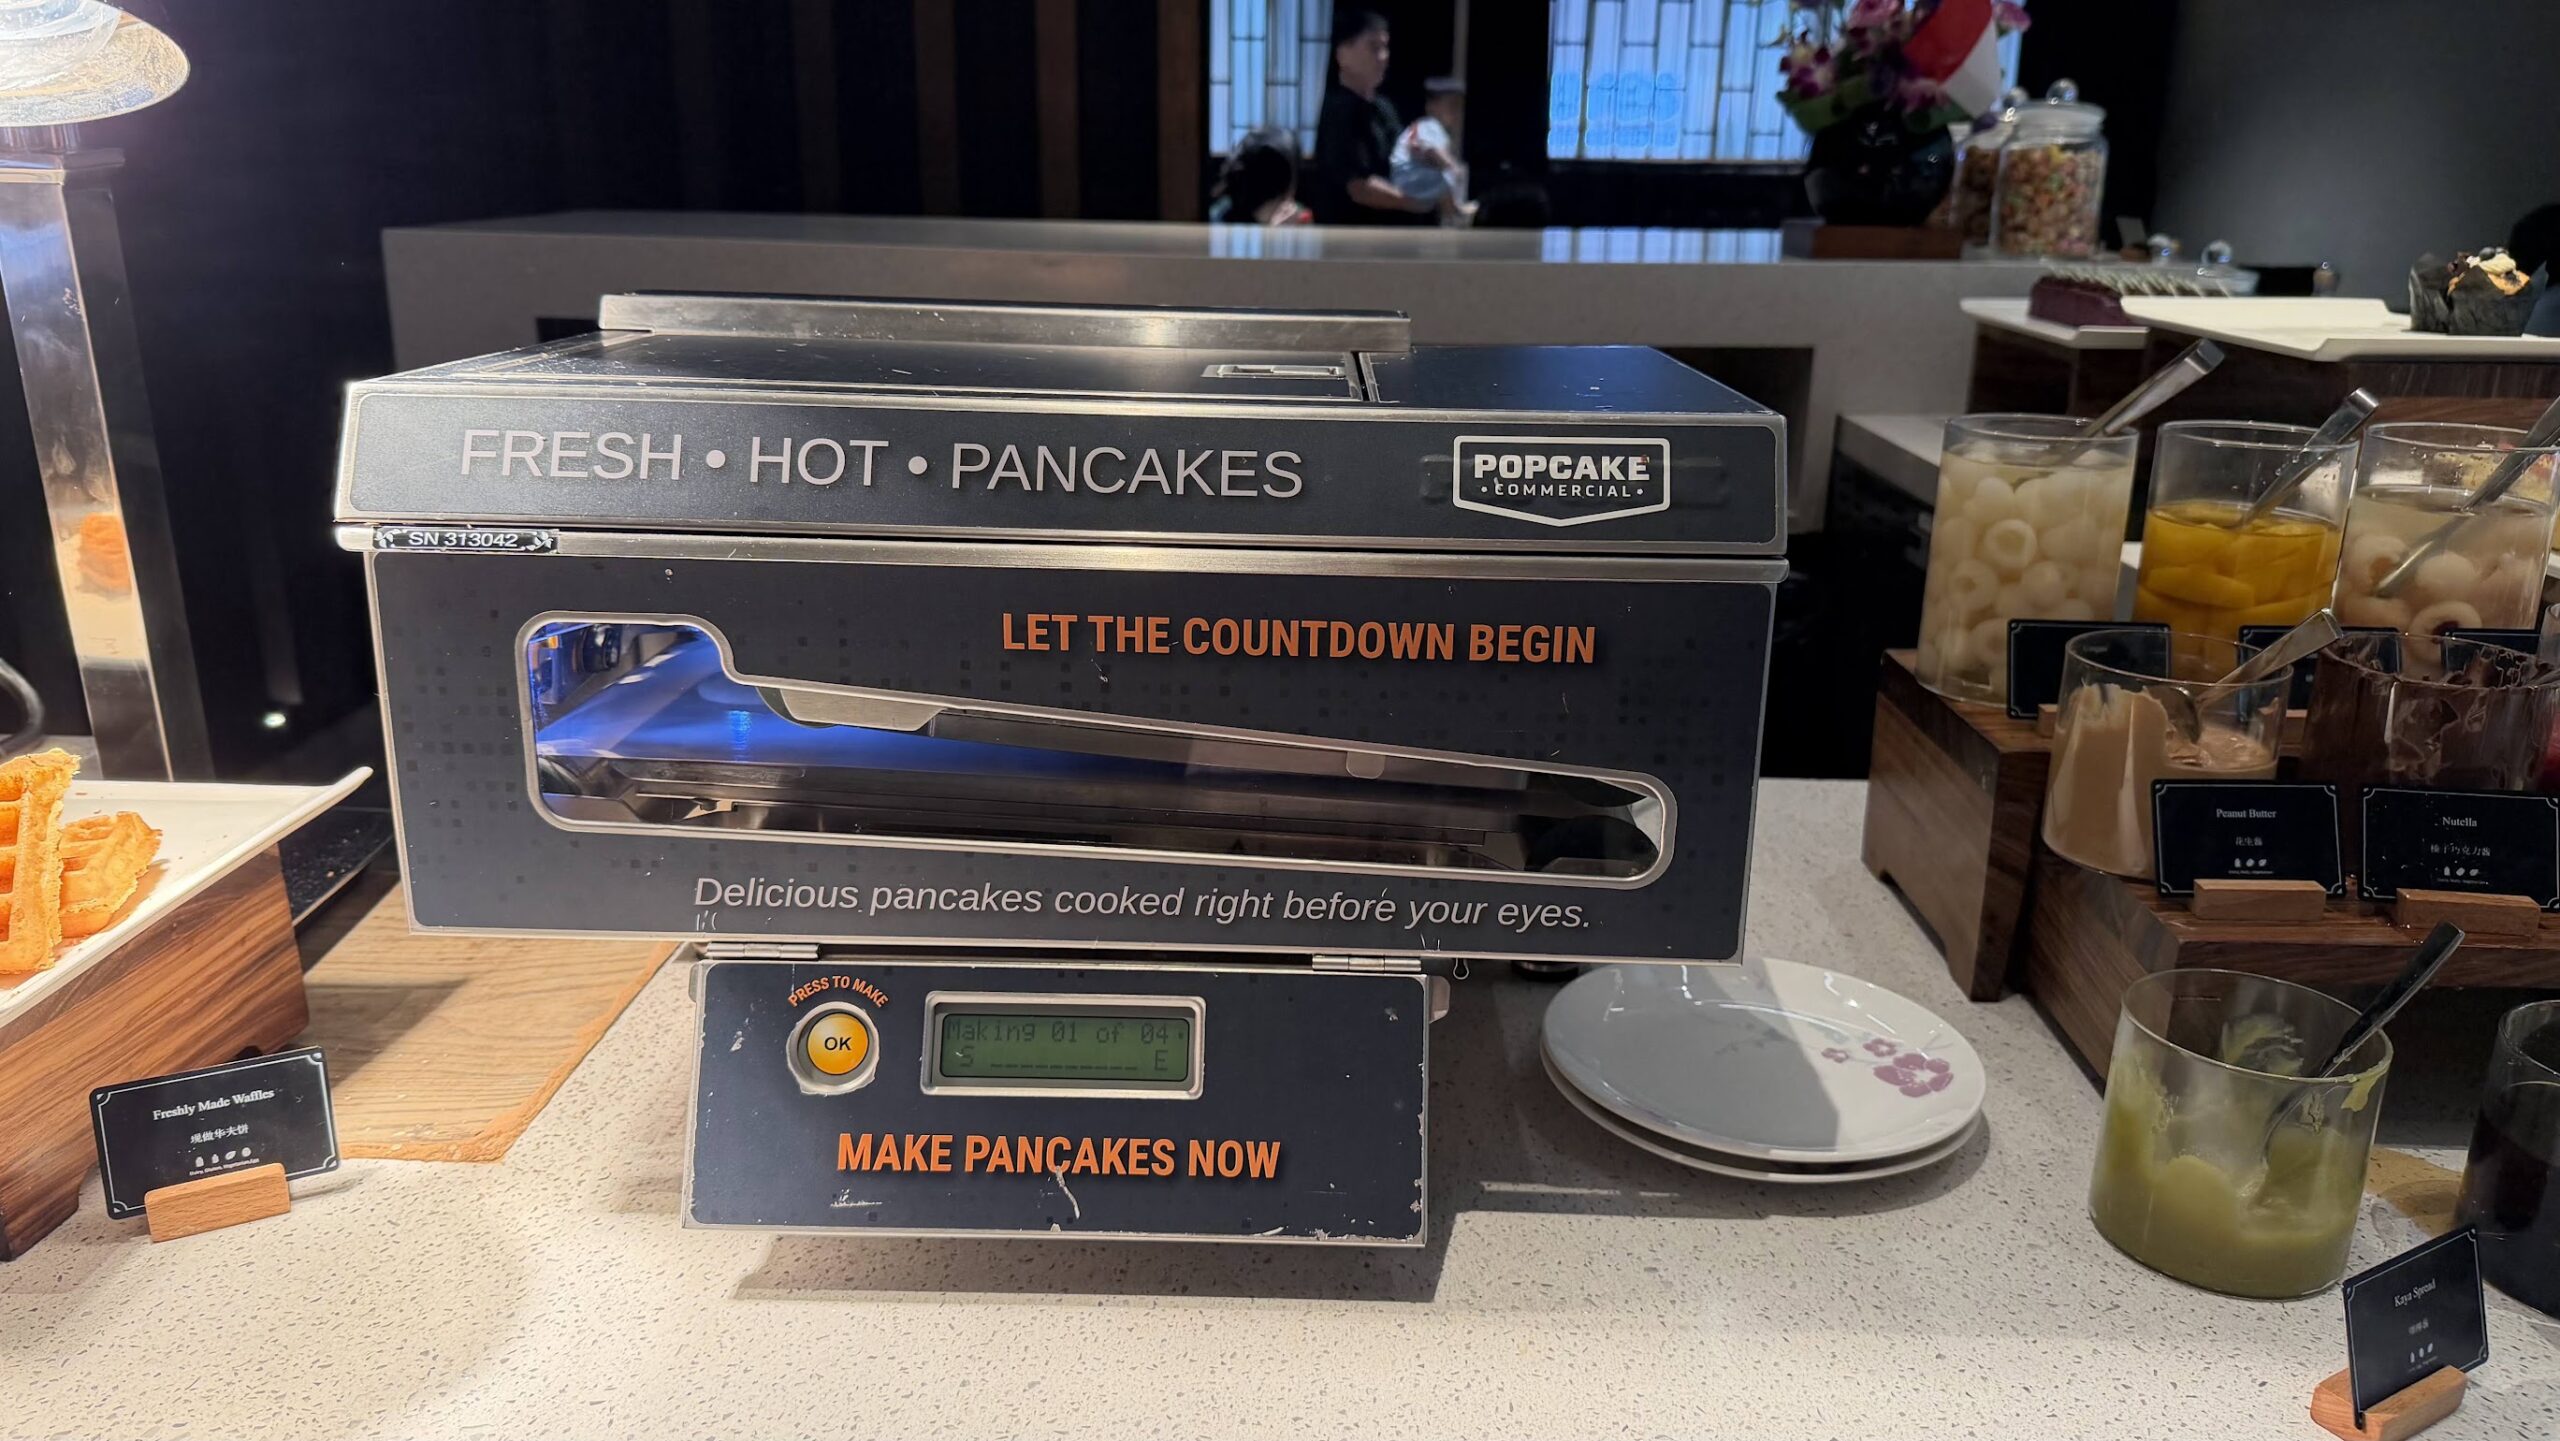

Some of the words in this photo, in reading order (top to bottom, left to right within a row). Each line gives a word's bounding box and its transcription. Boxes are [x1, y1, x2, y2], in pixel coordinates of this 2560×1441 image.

[461, 428, 682, 480] FRESH
[750, 436, 889, 486] HOT
[951, 443, 1303, 497] PANCAKES
[1474, 454, 1650, 481] POPCAKE
[1495, 483, 1631, 497] COMMERCIAL
[408, 531, 439, 546] SN
[444, 532, 518, 547] 313042
[1002, 612, 1078, 651] LET
[1087, 614, 1171, 654] THE
[1183, 616, 1455, 661] COUNTDOWN
[1468, 623, 1596, 664] BEGIN
[2216, 808, 2247, 818] Peanut
[2249, 808, 2277, 818] Butter
[2442, 816, 2478, 827] Nutella
[695, 877, 859, 909] Delicious
[869, 882, 1043, 916] pancakes
[1054, 885, 1186, 917] cooked
[1194, 888, 1274, 924] right
[1283, 891, 1396, 921] before
[1404, 899, 1488, 930] your
[1497, 902, 1591, 933] eyes.
[788, 977, 830, 1007] PRESS
[832, 975, 850, 988] TO
[852, 978, 889, 1007] MAKE
[824, 1036, 852, 1051] OK
[946, 1020, 1036, 1042] Making
[1052, 1021, 1078, 1042] 01
[1096, 1022, 1122, 1043] of
[1141, 1023, 1169, 1044] 04
[153, 1104, 195, 1120] Freshly
[198, 1098, 231, 1112] Made
[233, 1090, 275, 1104] Waffles
[837, 1133, 954, 1172] MAKE
[964, 1134, 1176, 1175] PANCAKES
[1187, 1139, 1281, 1179] NOW
[2394, 1292, 2412, 1307] Kaya
[2412, 1278, 2436, 1299] Spread
